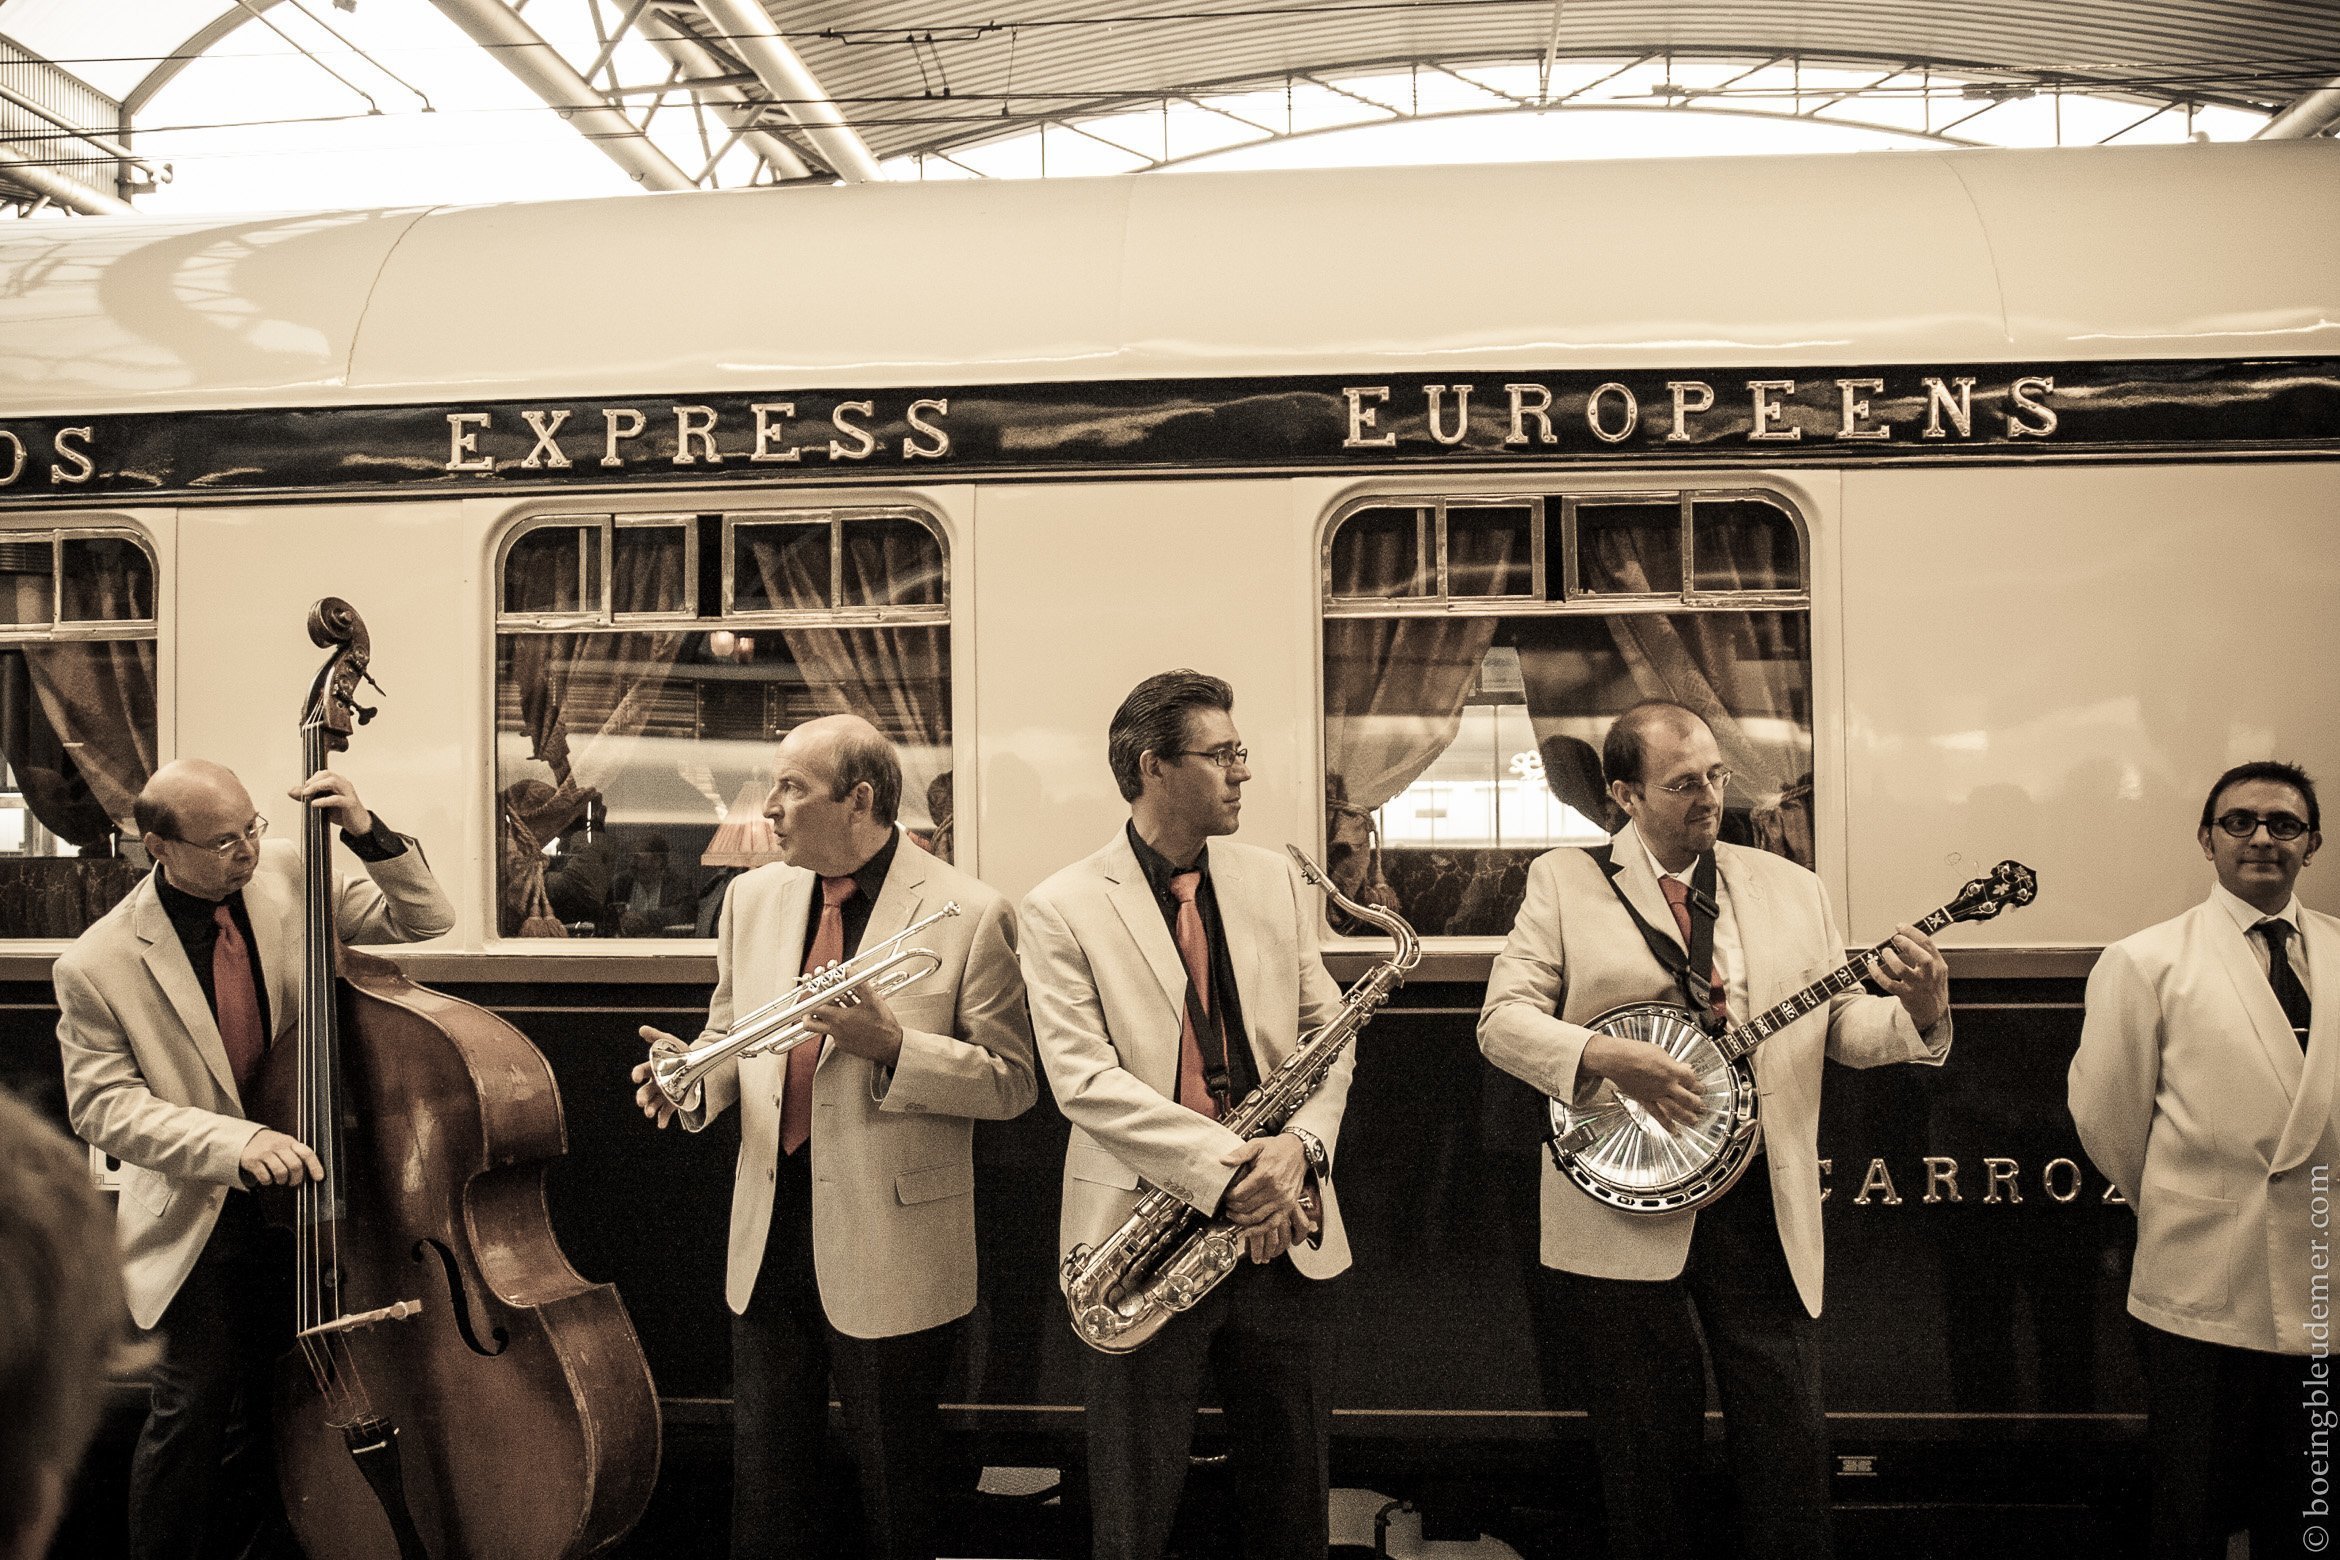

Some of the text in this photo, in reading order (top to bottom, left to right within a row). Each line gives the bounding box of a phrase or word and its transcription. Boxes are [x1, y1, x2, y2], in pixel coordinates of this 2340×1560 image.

[445, 398, 950, 472] EXPRESS
[1342, 376, 2059, 449] EUROPEENS
[1818, 1157, 2127, 1204] ARRO
